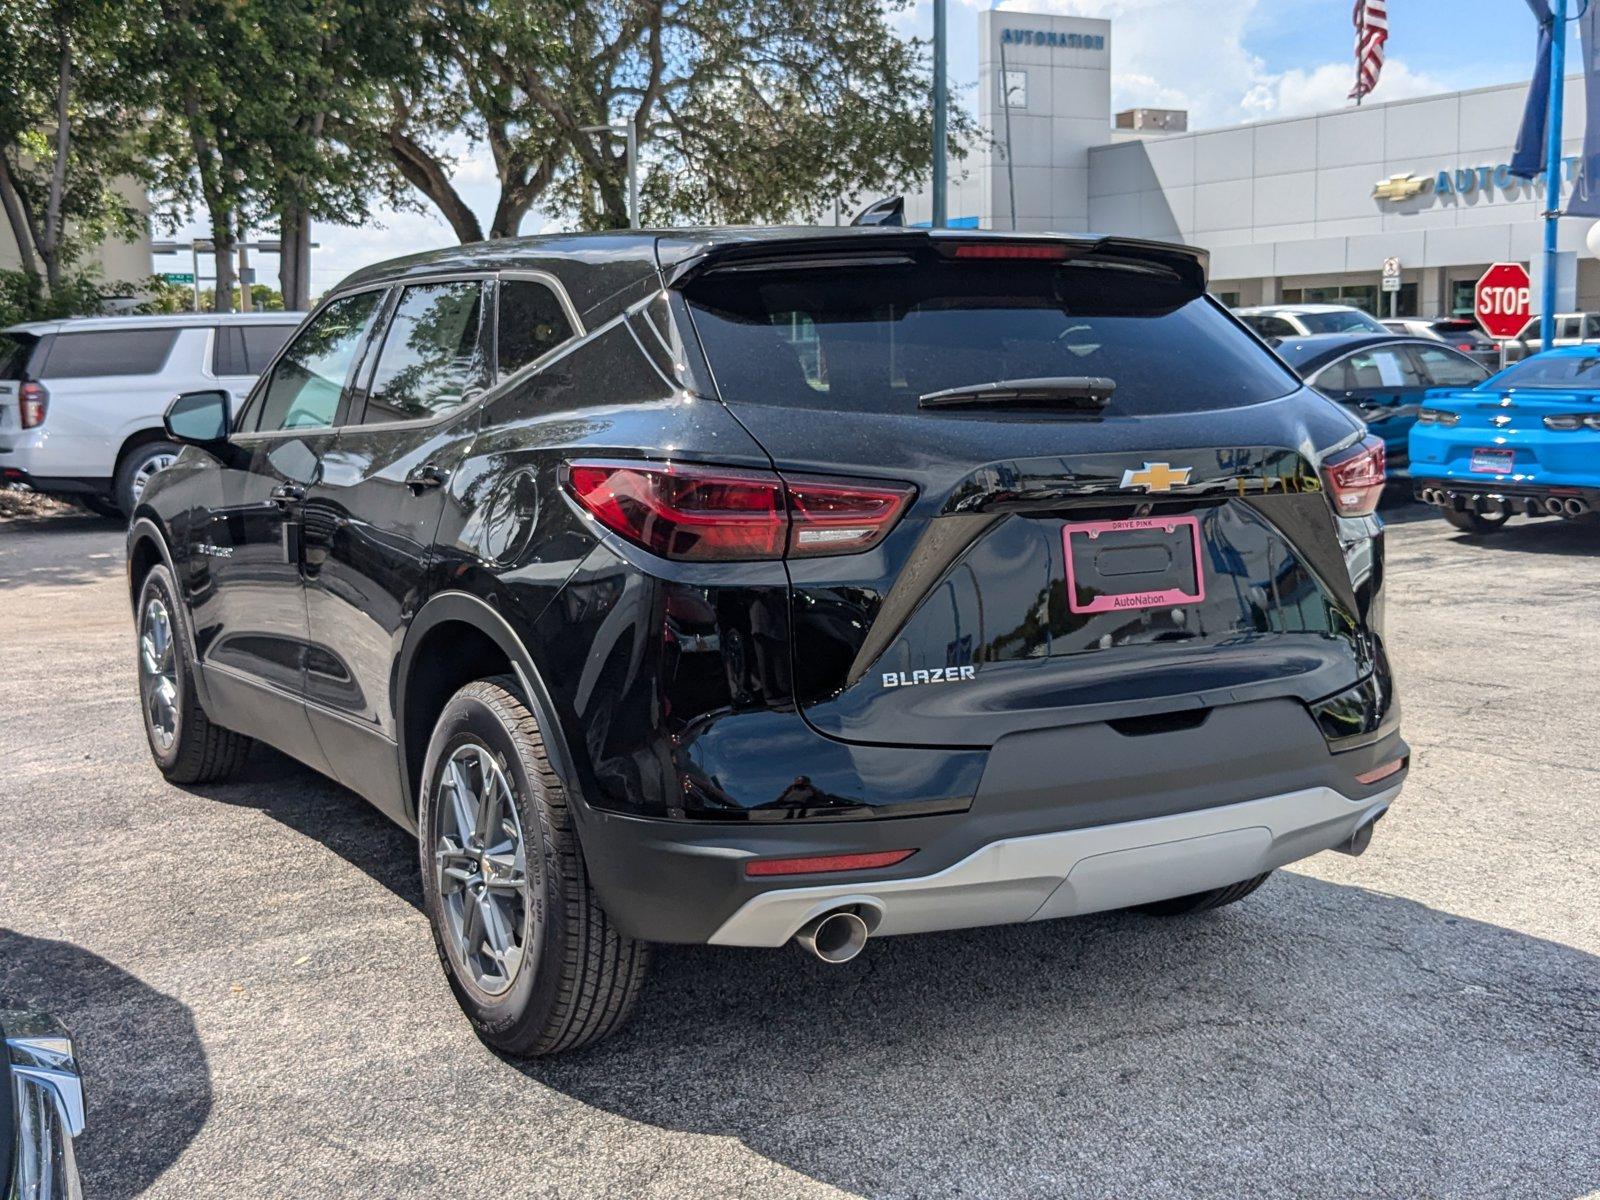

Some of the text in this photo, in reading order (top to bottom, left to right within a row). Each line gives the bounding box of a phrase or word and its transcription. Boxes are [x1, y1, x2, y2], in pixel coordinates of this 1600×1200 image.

[1002, 28, 1104, 50] AUTONATION
[1433, 157, 1579, 196] AUTOT
[1480, 286, 1530, 315] STOP
[1112, 520, 1153, 530] DRIVE PINK
[1113, 595, 1165, 608] AutoNation
[882, 665, 976, 688] BLAZER
